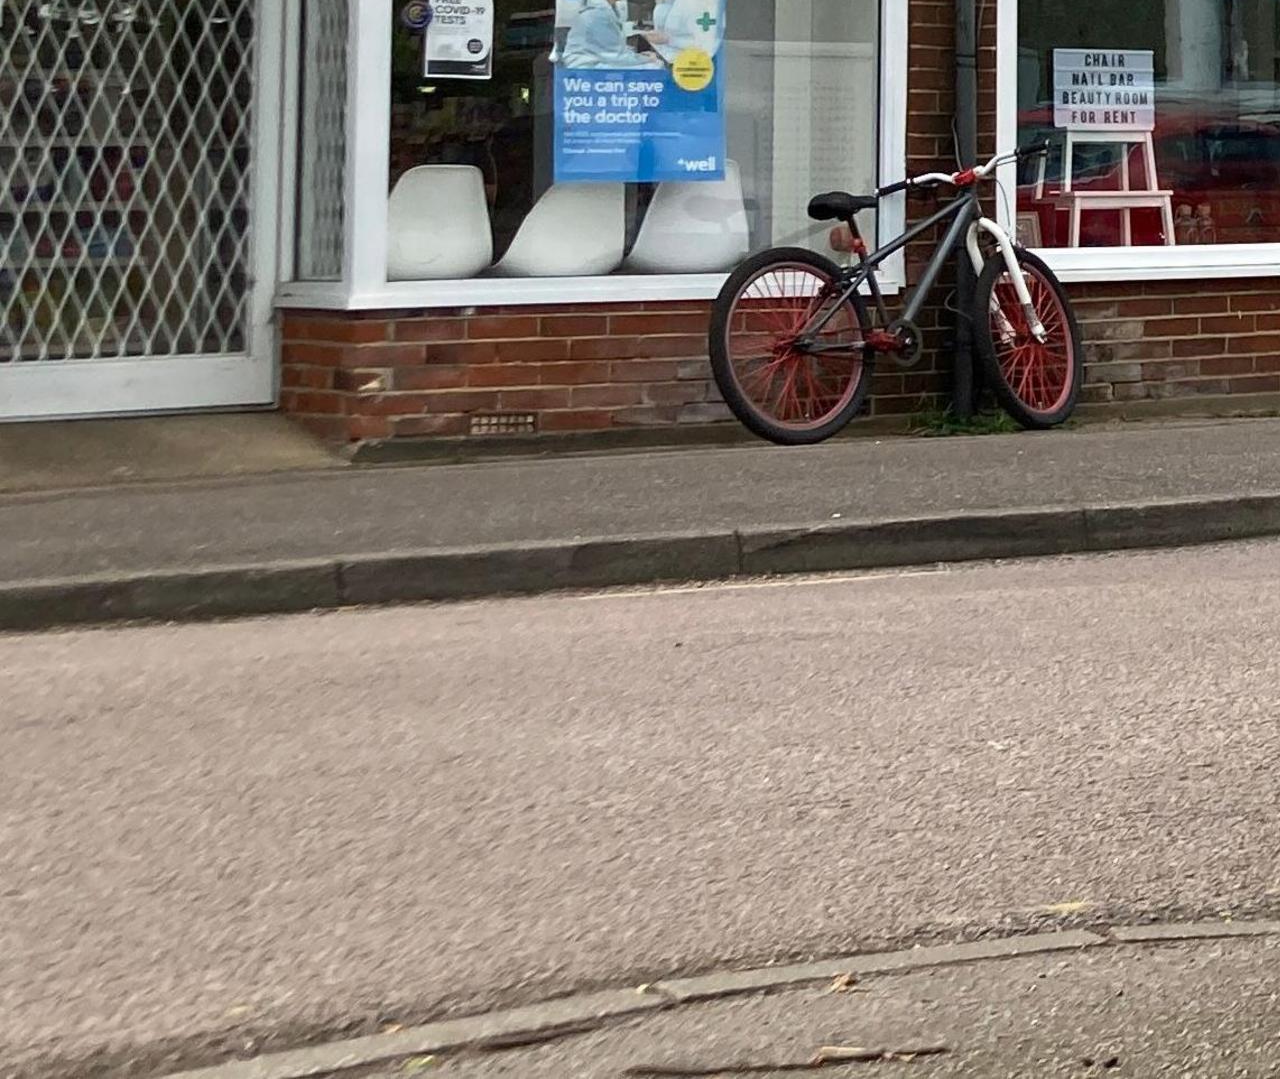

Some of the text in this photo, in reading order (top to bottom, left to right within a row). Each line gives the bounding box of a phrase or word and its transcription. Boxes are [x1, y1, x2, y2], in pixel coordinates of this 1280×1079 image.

[435, 5, 485, 15] COVID-19
[434, 15, 466, 25] TESTS
[1084, 54, 1125, 68] CHAIR
[563, 77, 664, 93] We can save
[1072, 72, 1135, 87] NAIL BAR
[563, 93, 660, 111] you a trip to
[1062, 91, 1148, 106] BEAUTY ROOM
[564, 109, 649, 124] the doctor
[1072, 111, 1136, 124] FOR RENT
[684, 156, 716, 172] well
